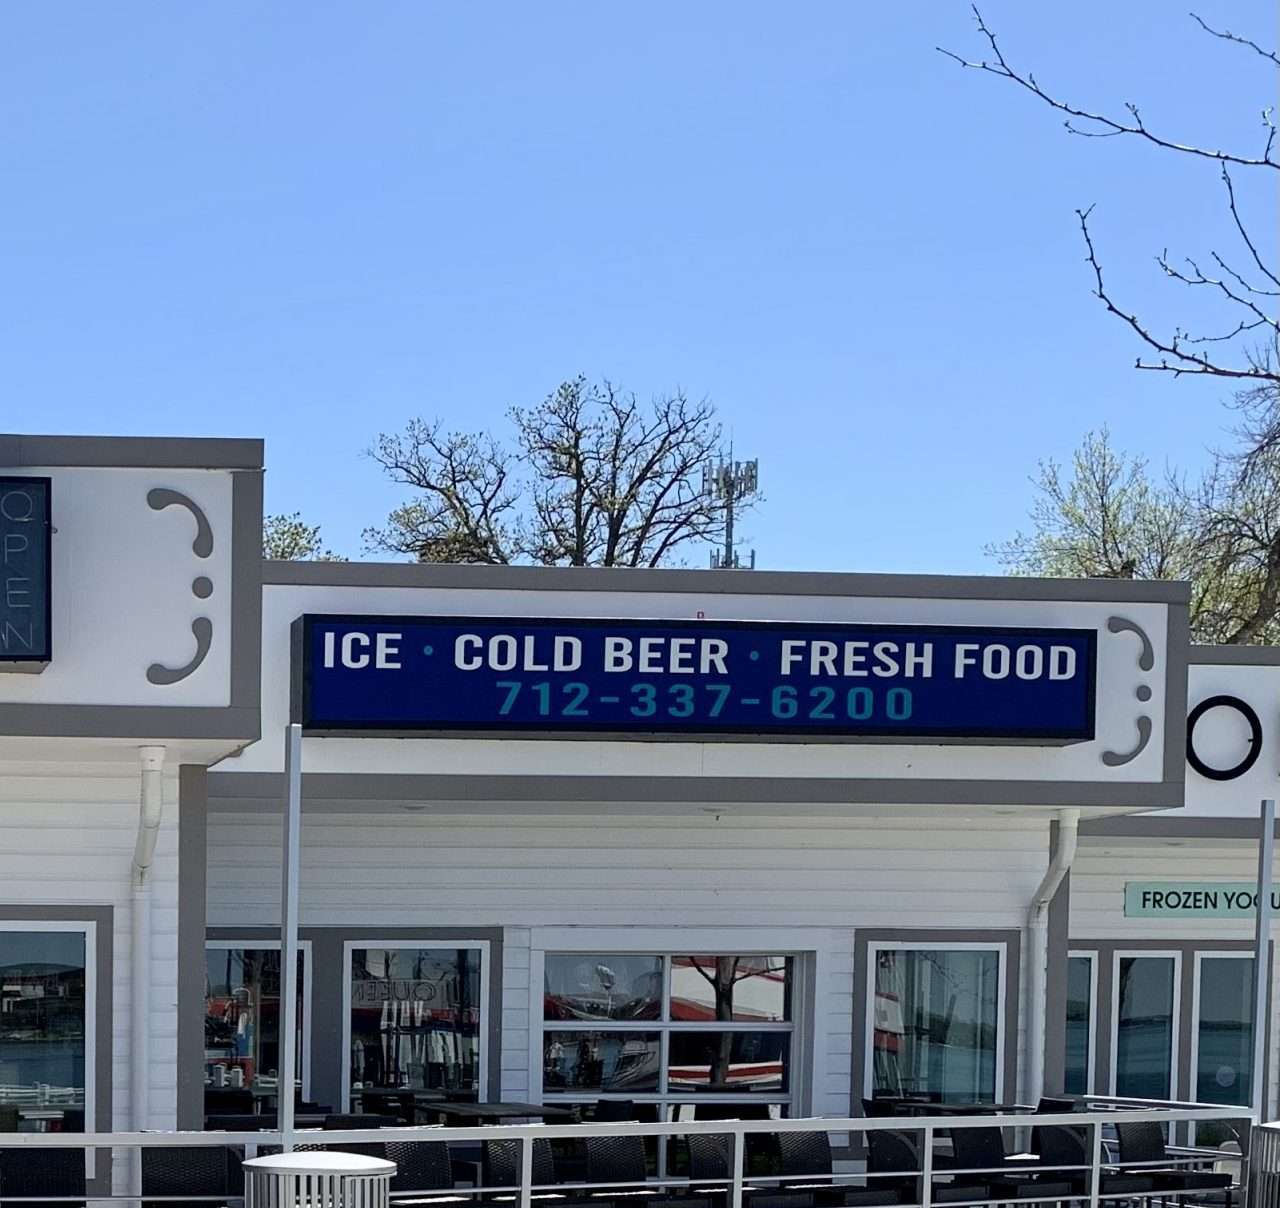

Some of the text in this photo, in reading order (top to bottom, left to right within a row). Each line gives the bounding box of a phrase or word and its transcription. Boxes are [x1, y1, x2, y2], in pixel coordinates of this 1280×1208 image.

[0, 490, 34, 650] OPEN
[323, 631, 1077, 681] ICE COLD BEER FRESH FOOD
[495, 680, 913, 721] 712-337-6200
[1142, 891, 1218, 909] FROZEN
